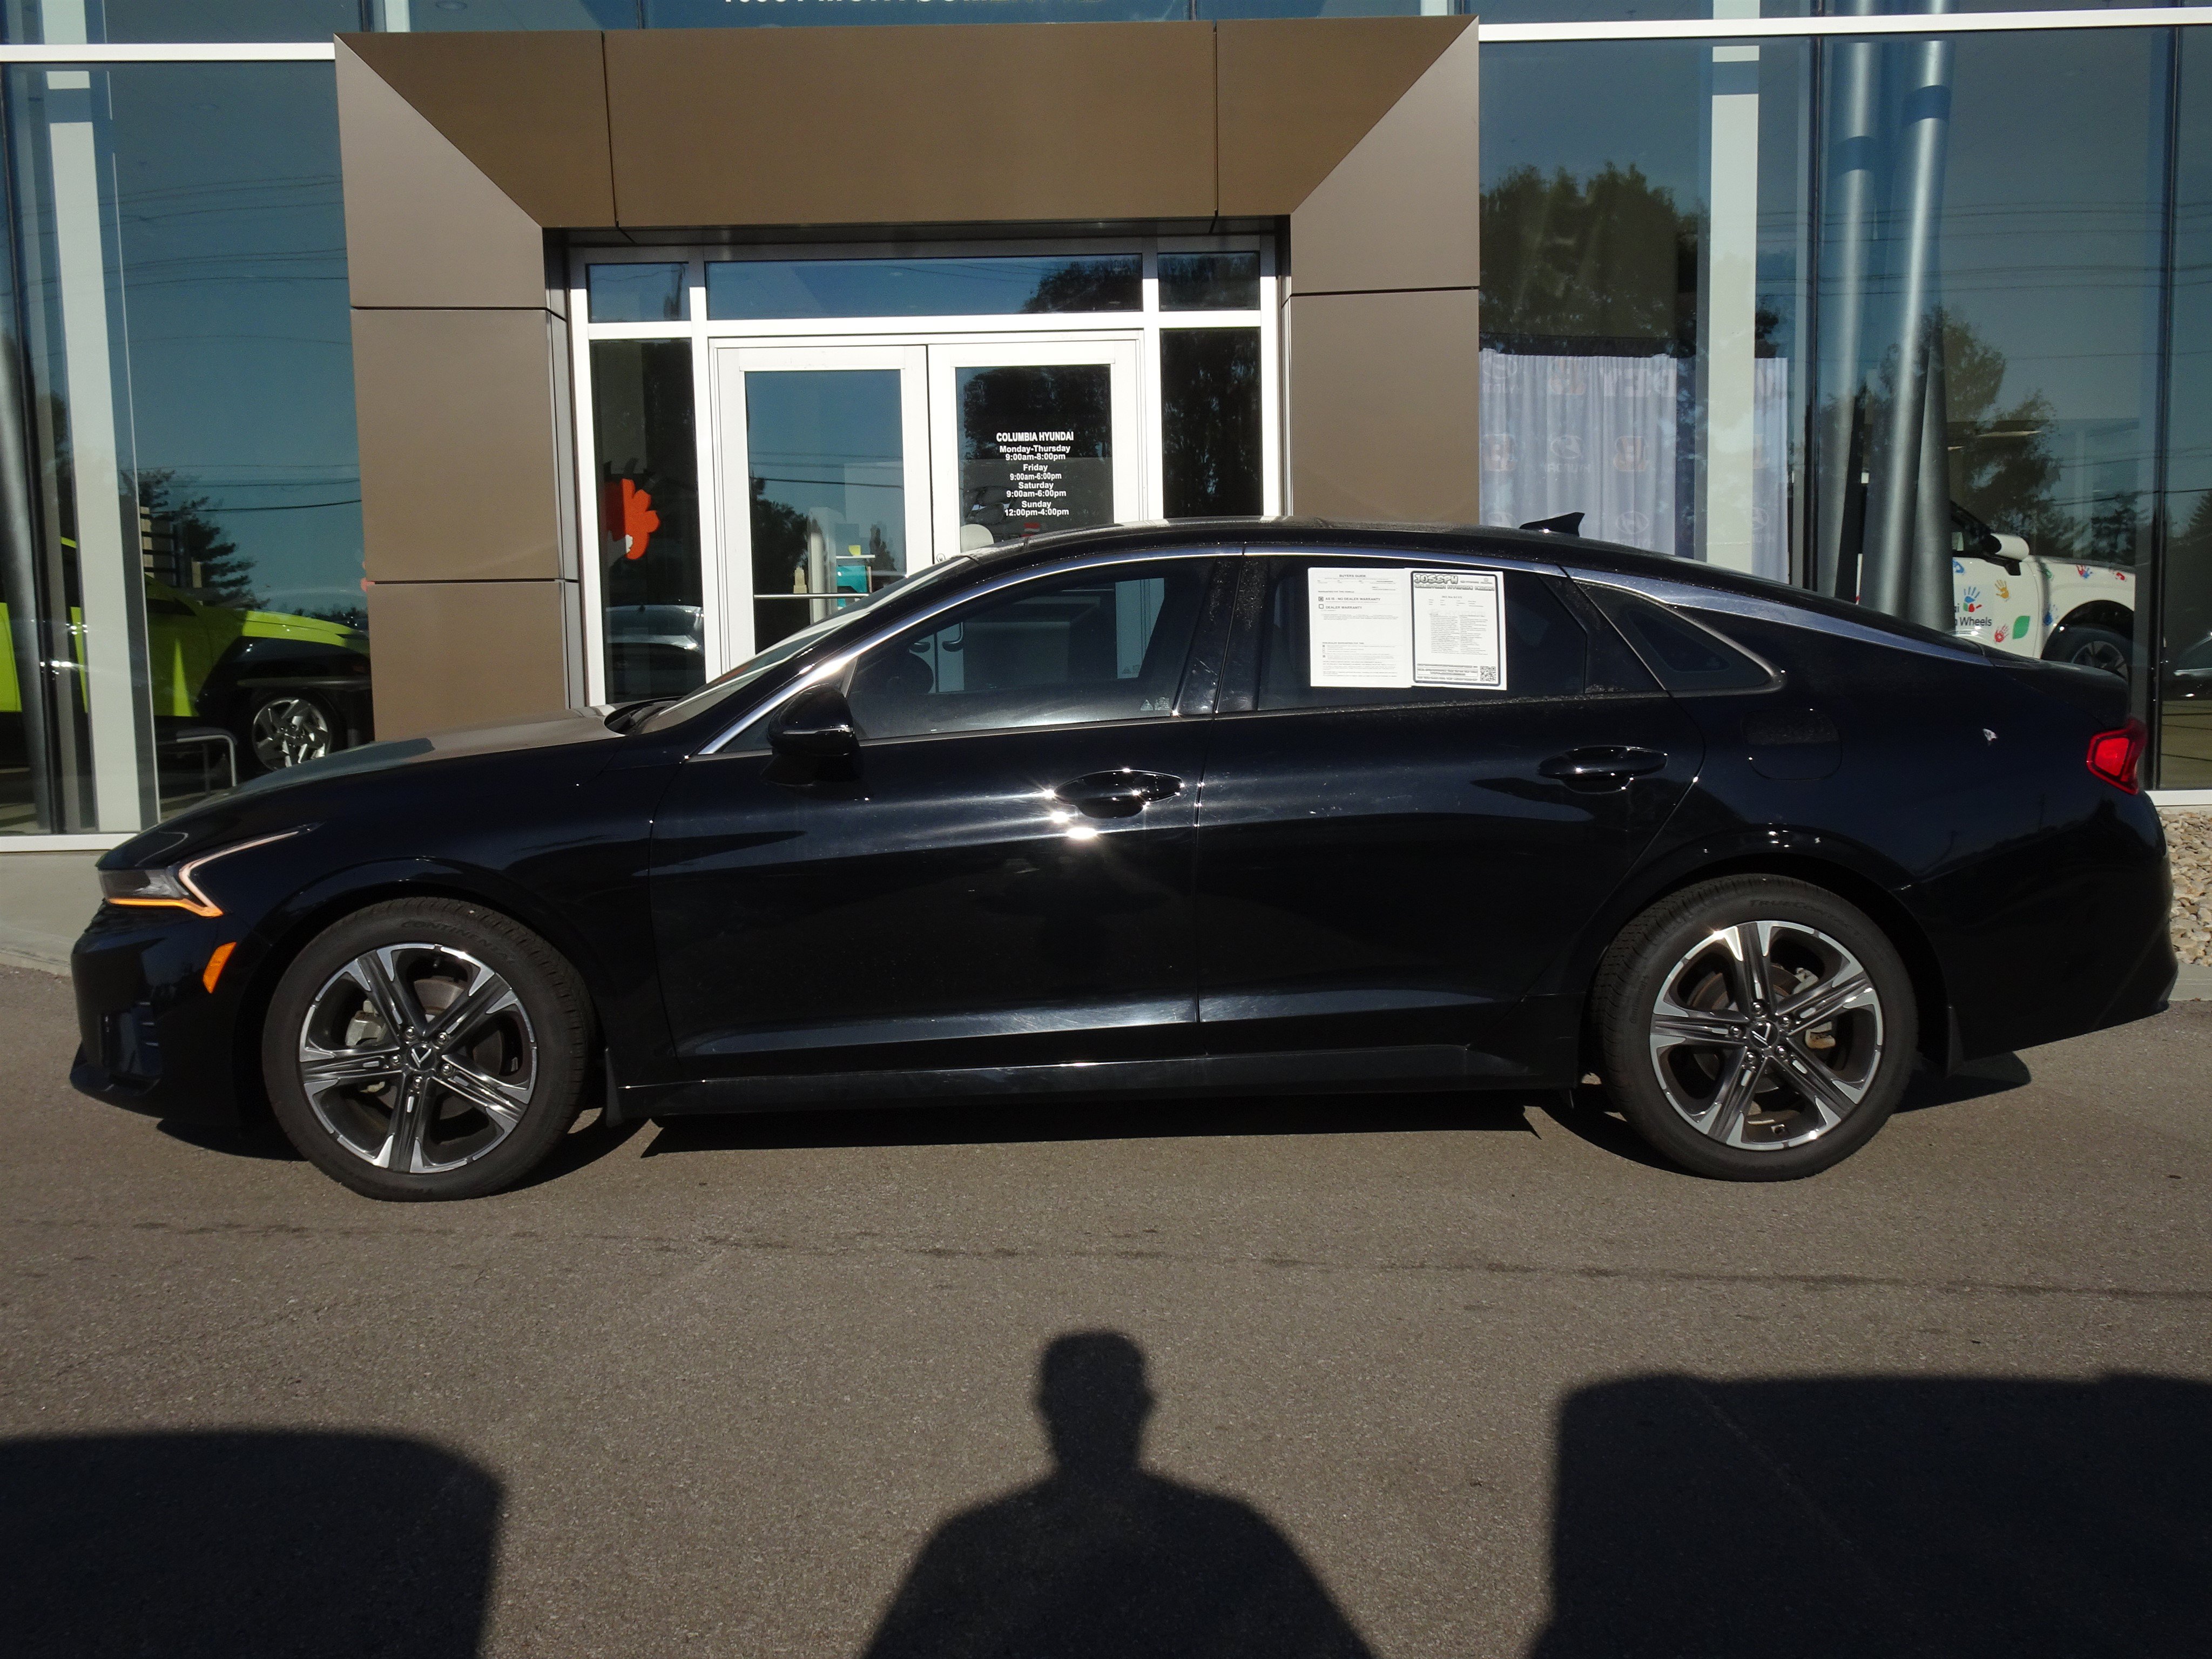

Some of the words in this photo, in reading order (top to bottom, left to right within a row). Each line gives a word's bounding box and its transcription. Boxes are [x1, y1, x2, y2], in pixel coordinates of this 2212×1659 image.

[996, 432, 1038, 442] COLUMBIA
[1039, 431, 1074, 441] HYUNDAI
[999, 444, 1071, 454] Monday-Thursday
[1005, 453, 1066, 461] 9:00am-8:00pm
[1023, 463, 1048, 472] Friday
[1009, 473, 1062, 481] 9:00am-6:00pm
[1018, 481, 1054, 490] Saturday
[1006, 489, 1067, 498] 9:00am-6:00pm
[1021, 500, 1051, 509] Sunday
[1004, 508, 1070, 517] 12:00pm-4:00pm
[1414, 574, 1458, 584] JOSEPH
[1959, 616, 1992, 626] Wheels
